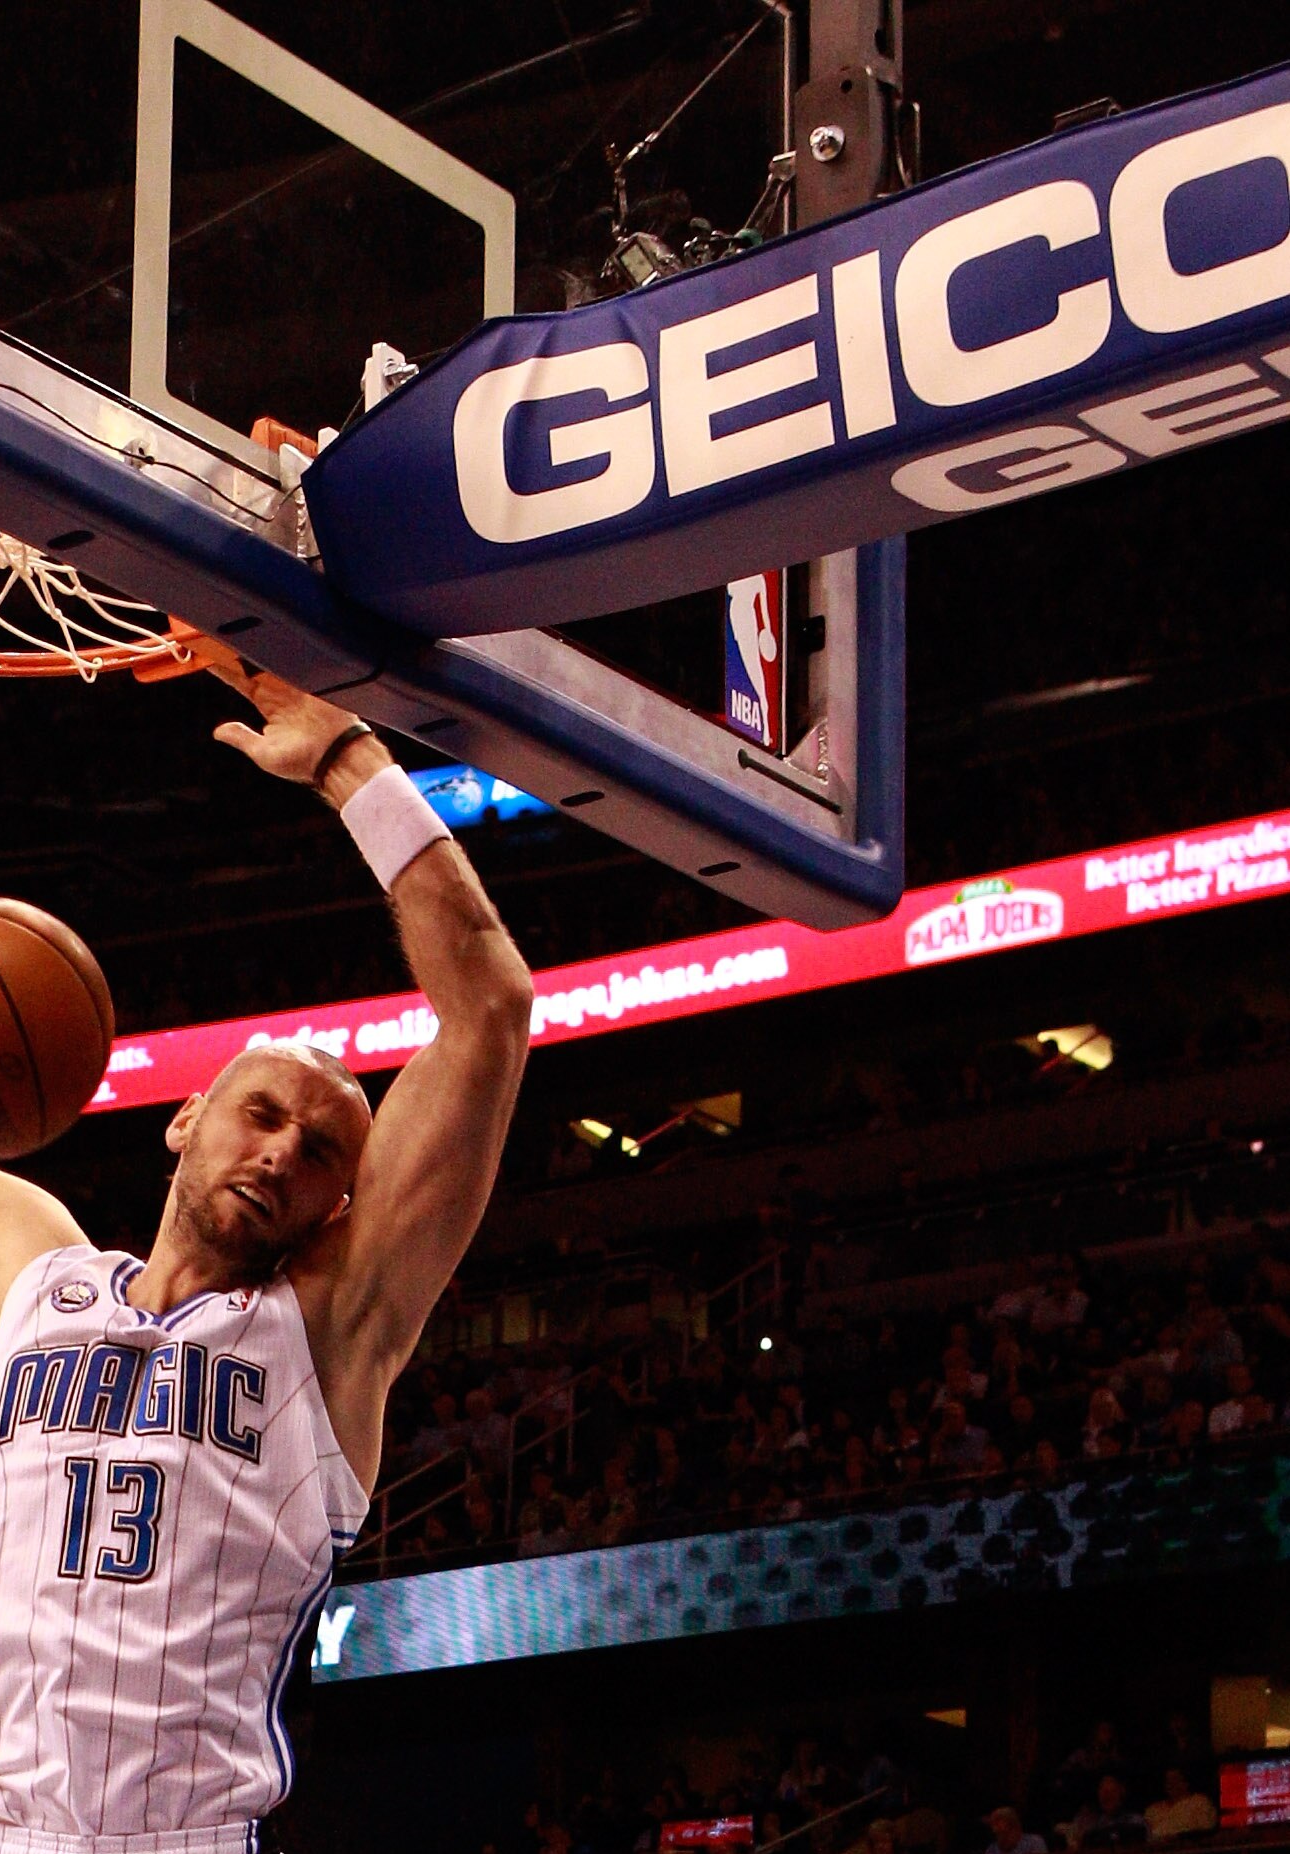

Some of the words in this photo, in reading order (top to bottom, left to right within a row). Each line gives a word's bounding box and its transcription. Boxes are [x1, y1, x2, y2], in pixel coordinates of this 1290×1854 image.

[453, 104, 1290, 544] GEICO
[731, 689, 761, 731] NBA
[1085, 850, 1169, 891] Better
[1127, 873, 1212, 914] Better
[910, 913, 968, 953] PAPA
[58, 1456, 166, 1583] 13
